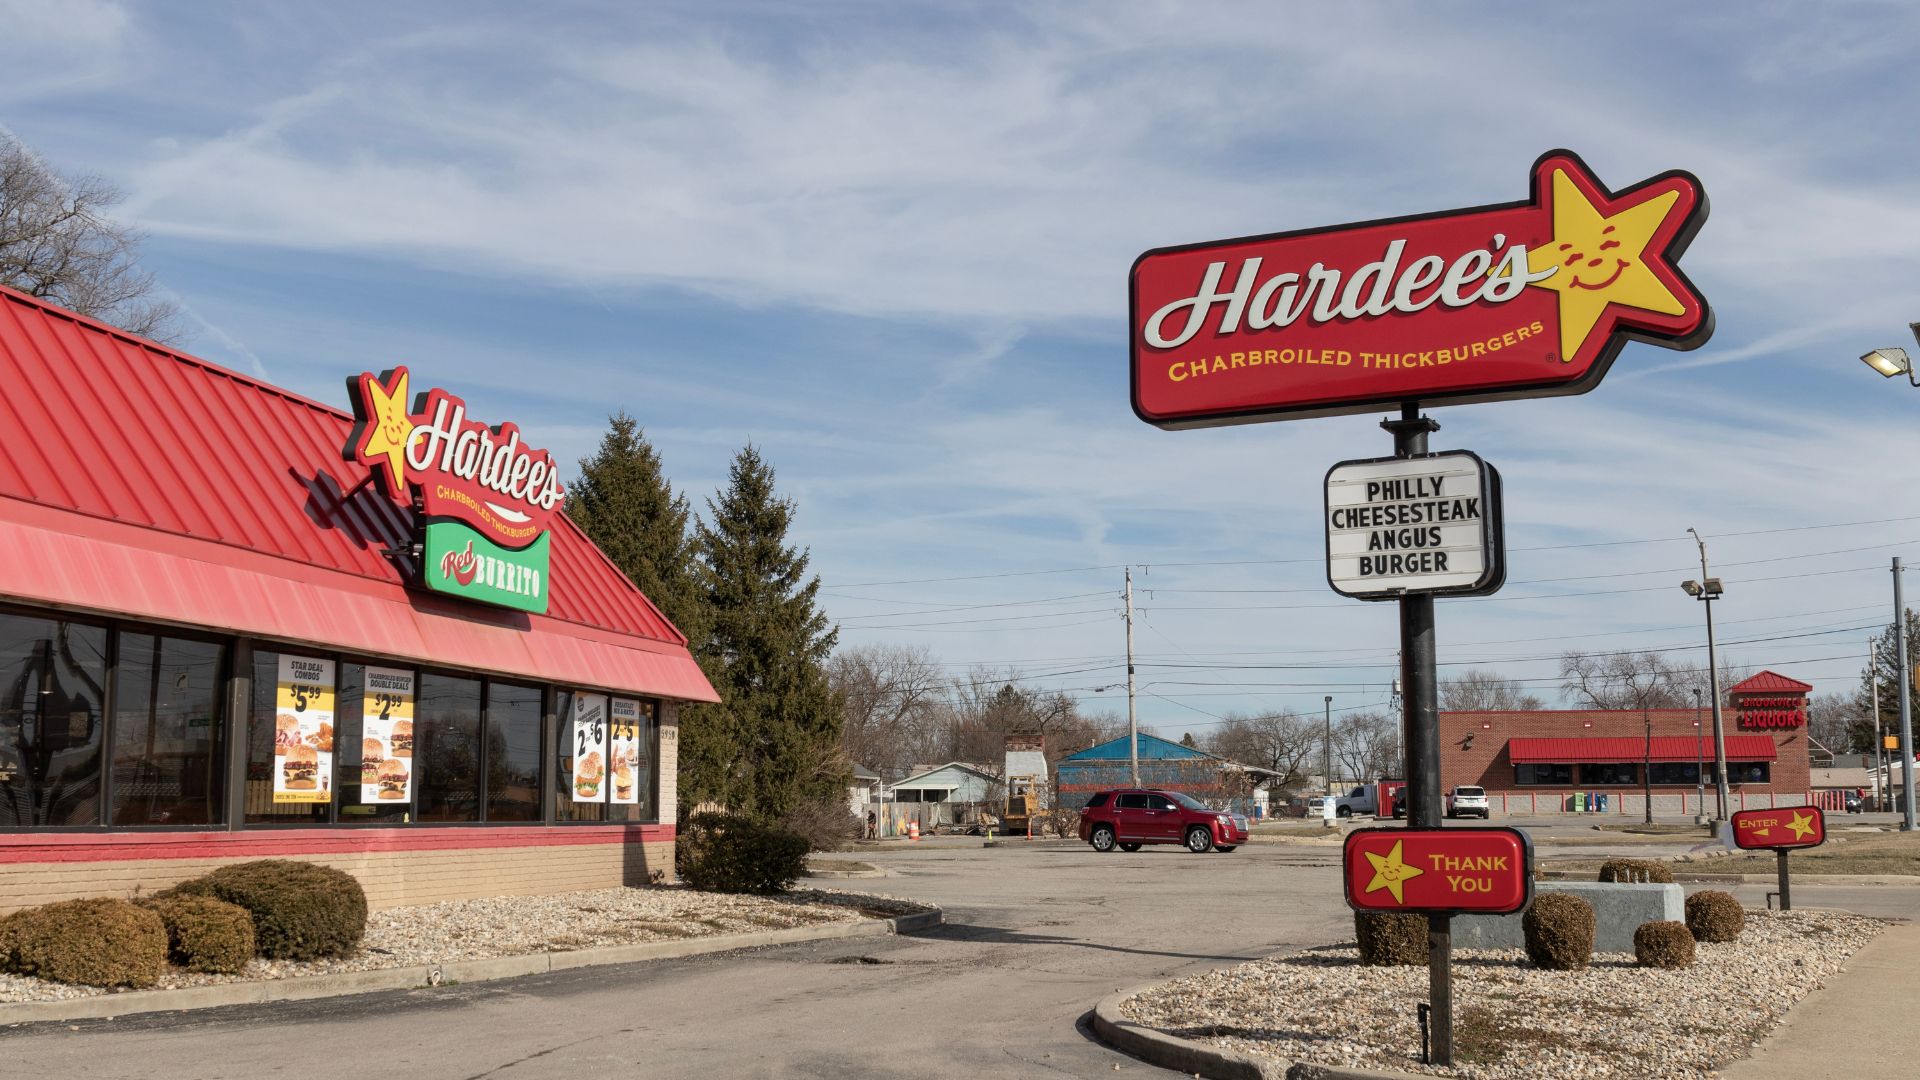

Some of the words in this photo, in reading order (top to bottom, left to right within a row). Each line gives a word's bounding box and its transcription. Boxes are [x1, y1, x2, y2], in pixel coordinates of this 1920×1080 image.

[1144, 233, 1558, 349] Hardee's
[1168, 348, 1352, 382] CHARBROILED
[1359, 321, 1543, 369] THICKBURGERS
[405, 398, 565, 510] Hardee's
[1367, 476, 1444, 502] PHILLY
[436, 485, 491, 523] CHARBROILED
[491, 516, 537, 539] THICKBURGERS
[1331, 498, 1480, 528] CHEESESTEAK
[1368, 526, 1442, 551] ANGUS
[440, 540, 477, 586] Red
[475, 554, 540, 599] BURRITO
[1359, 551, 1448, 576] BURGER
[290, 661, 307, 670] STAR
[308, 663, 324, 672] DEAL
[294, 670, 320, 680] COMBOS
[370, 680, 392, 688] DOUBLE
[392, 682, 408, 690] DEALS
[612, 718, 620, 740] 2
[1743, 710, 1804, 728] LIQUORS
[578, 730, 586, 757] 2
[1739, 818, 1778, 829] ENTER
[1428, 853, 1508, 872] THANK
[1446, 875, 1493, 893] YOU
